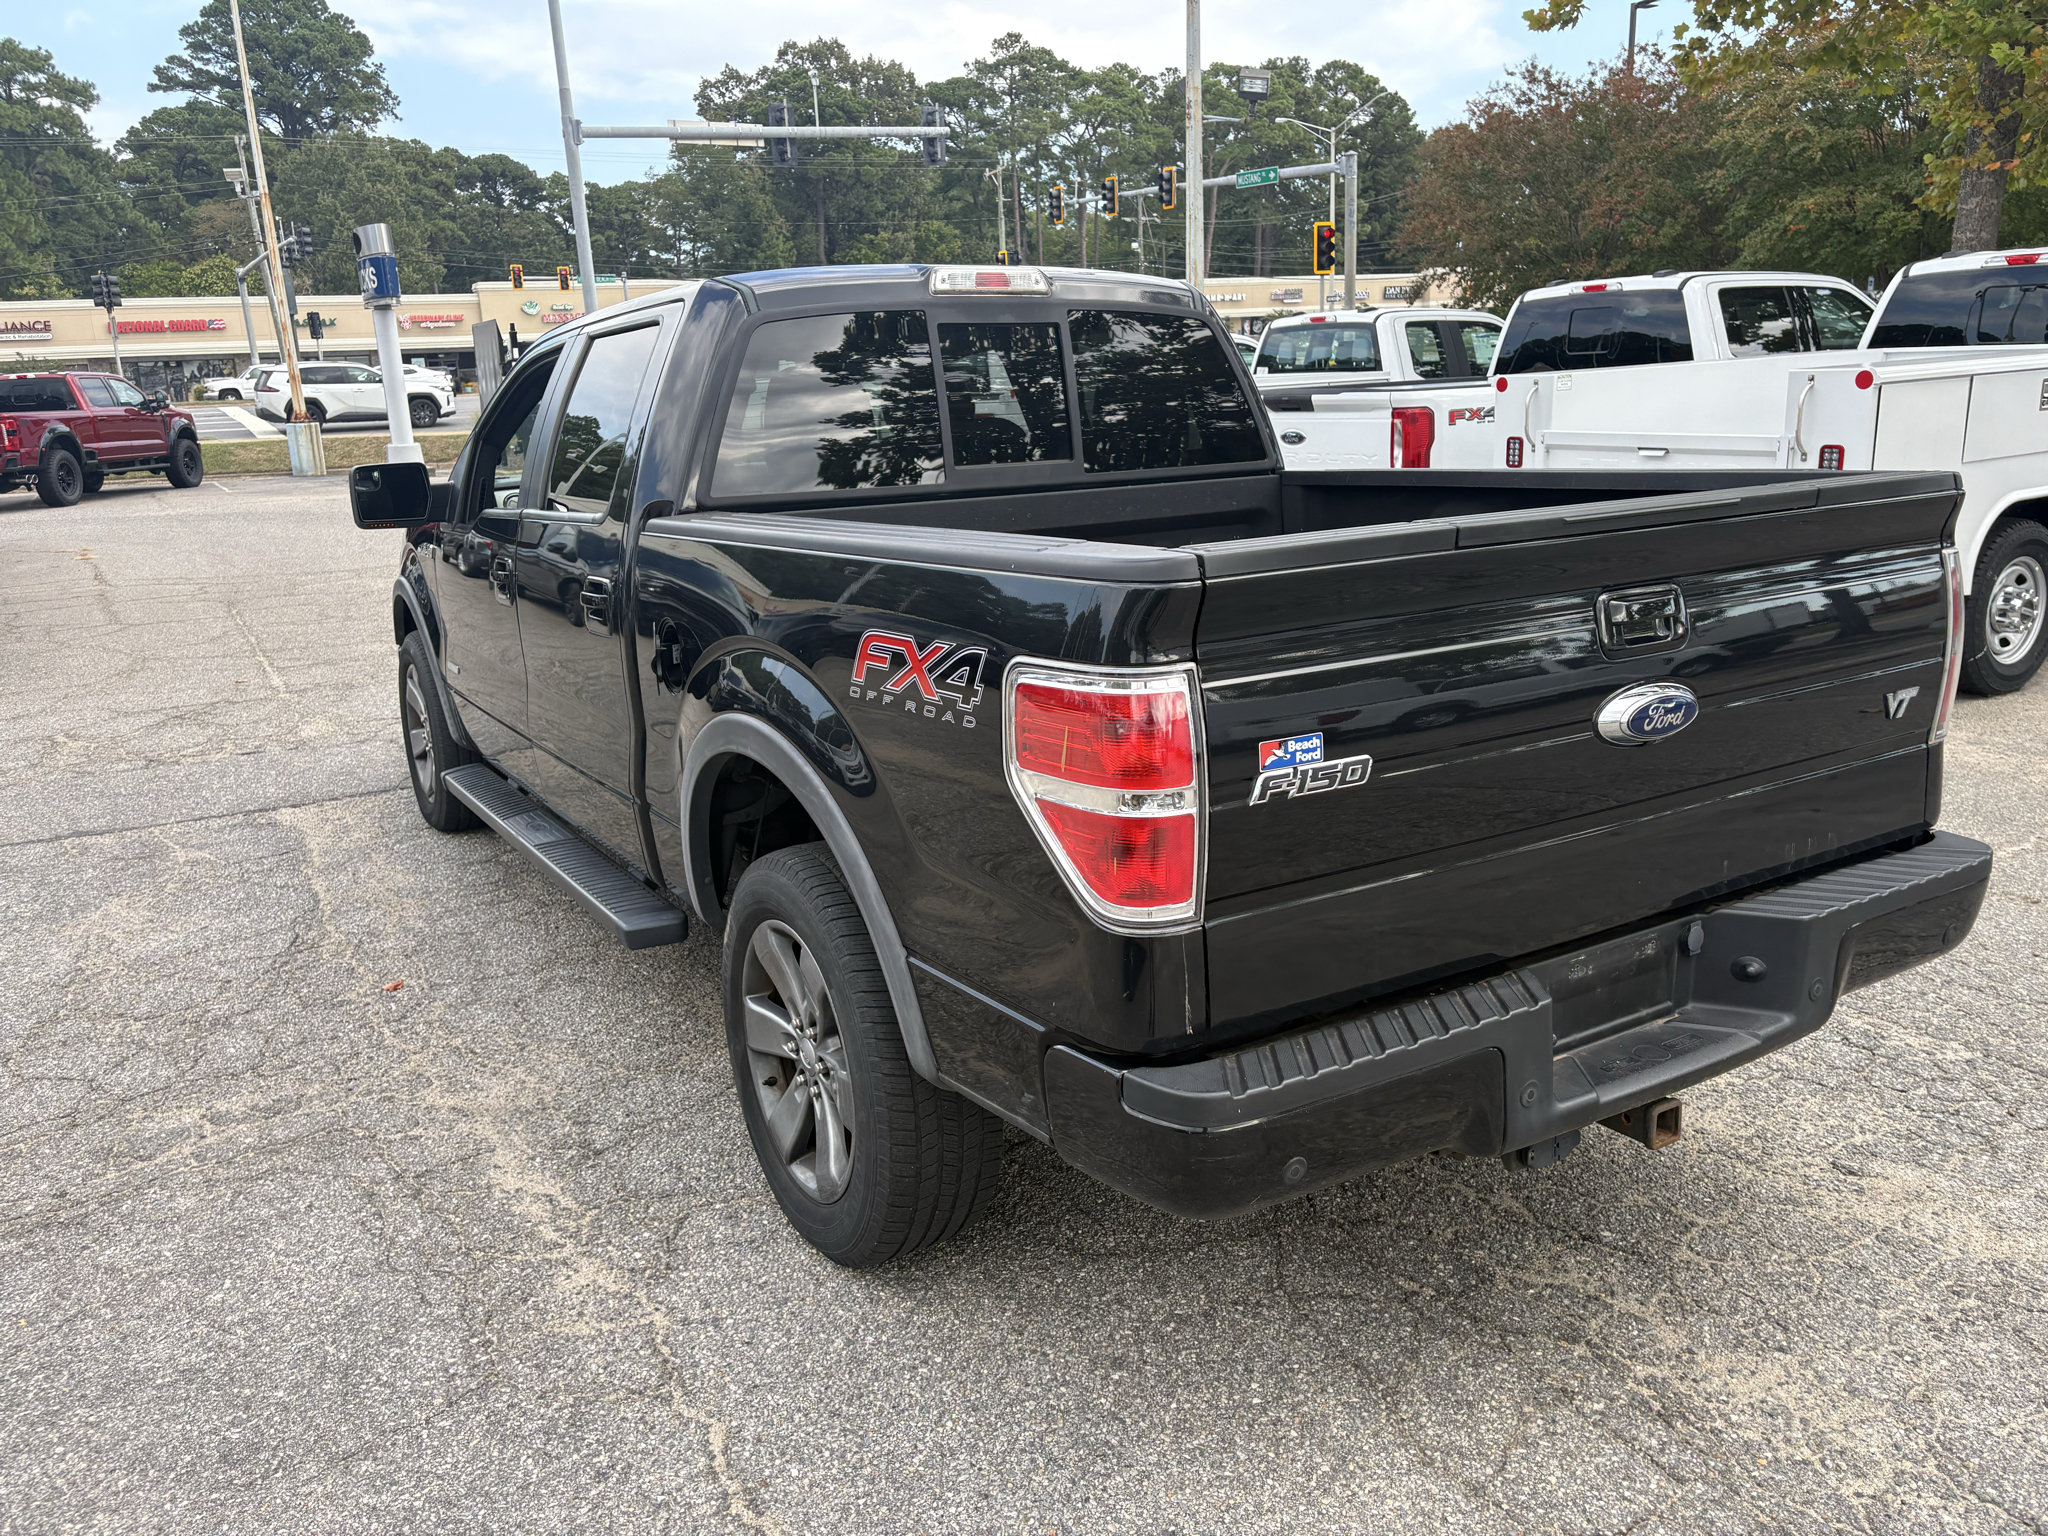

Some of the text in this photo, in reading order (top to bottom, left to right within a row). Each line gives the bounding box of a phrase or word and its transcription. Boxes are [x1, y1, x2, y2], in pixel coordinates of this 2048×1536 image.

[1238, 172, 1261, 185] MUSTANG
[168, 319, 208, 332] GUARD
[851, 629, 988, 712] FX4
[849, 686, 977, 729] OFF ROAD
[1643, 701, 1686, 731] Ford
[1883, 686, 1920, 719] VT
[1287, 737, 1320, 752] Beach
[1296, 748, 1320, 763] Ford
[1249, 754, 1373, 806] F-150
